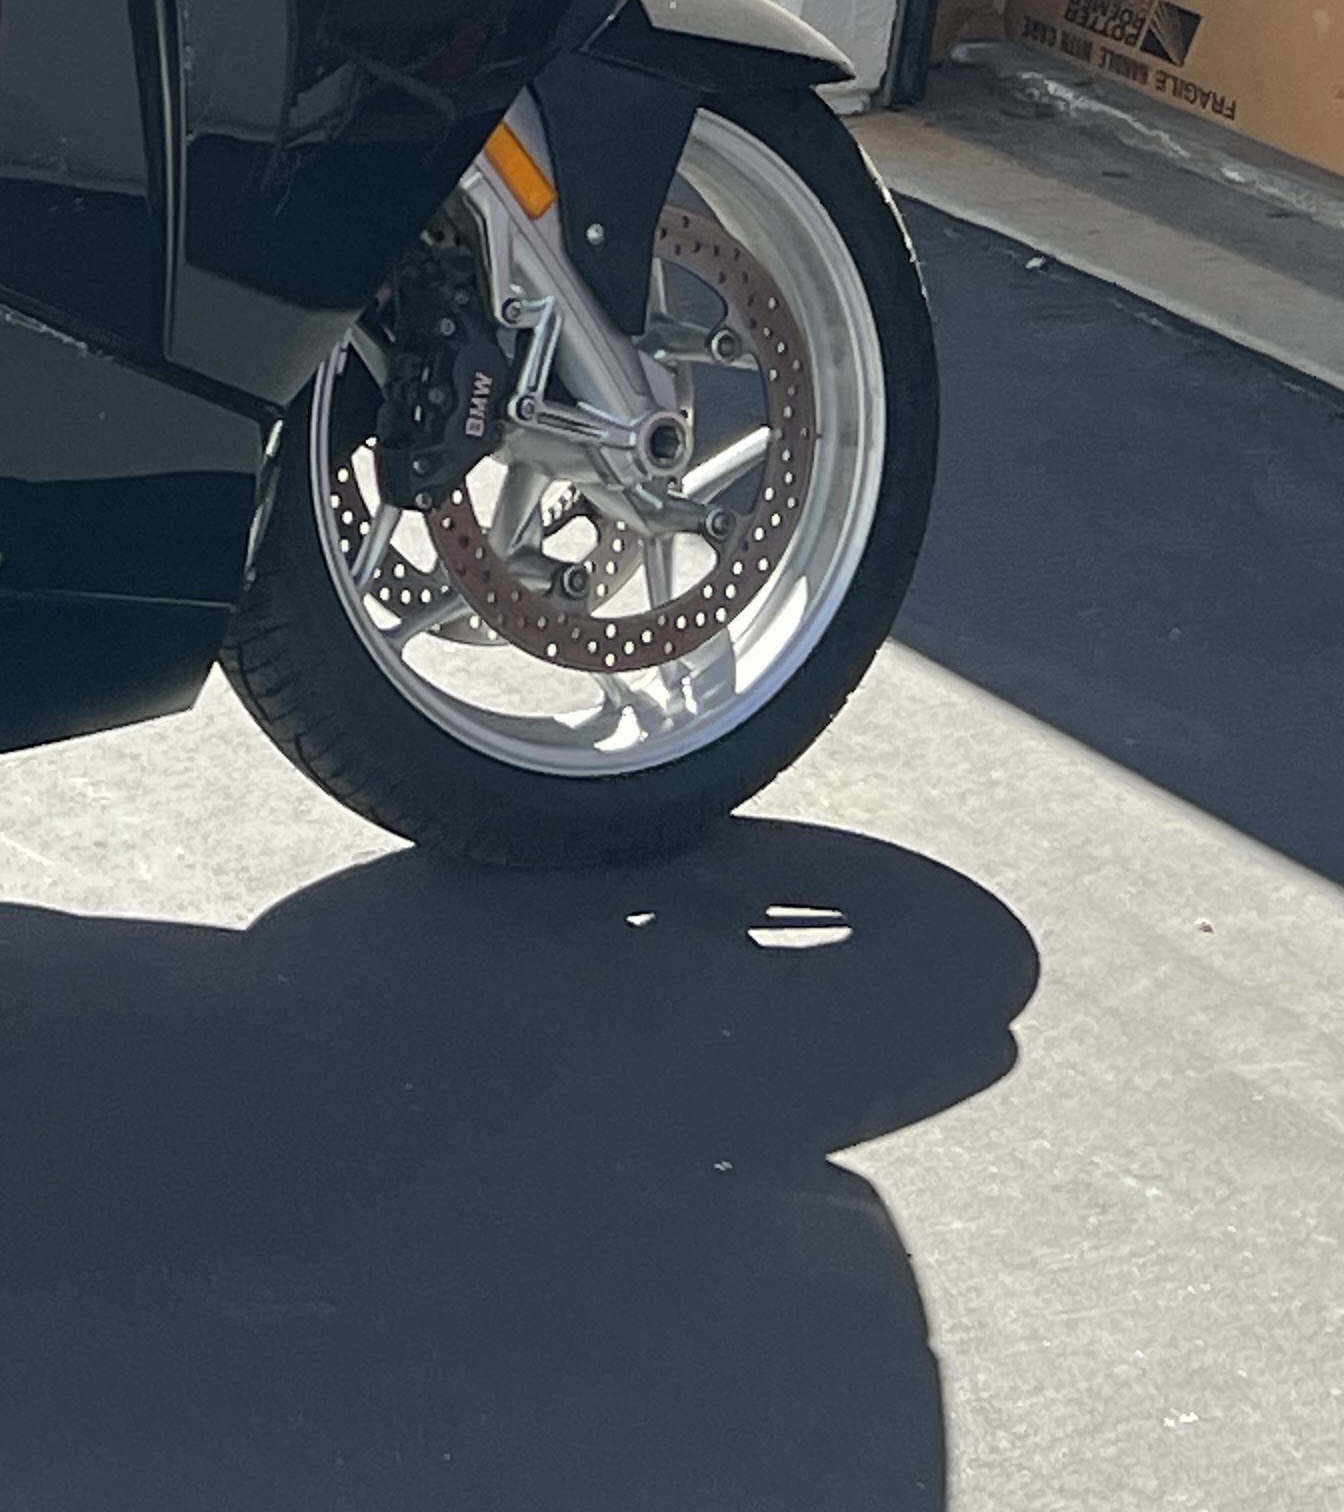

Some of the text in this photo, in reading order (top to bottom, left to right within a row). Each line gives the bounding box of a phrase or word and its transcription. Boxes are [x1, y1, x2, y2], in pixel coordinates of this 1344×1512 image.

[1064, 7, 1142, 47] POTTER
[1155, 69, 1237, 120] FRAGILE
[465, 371, 493, 437] BMW
